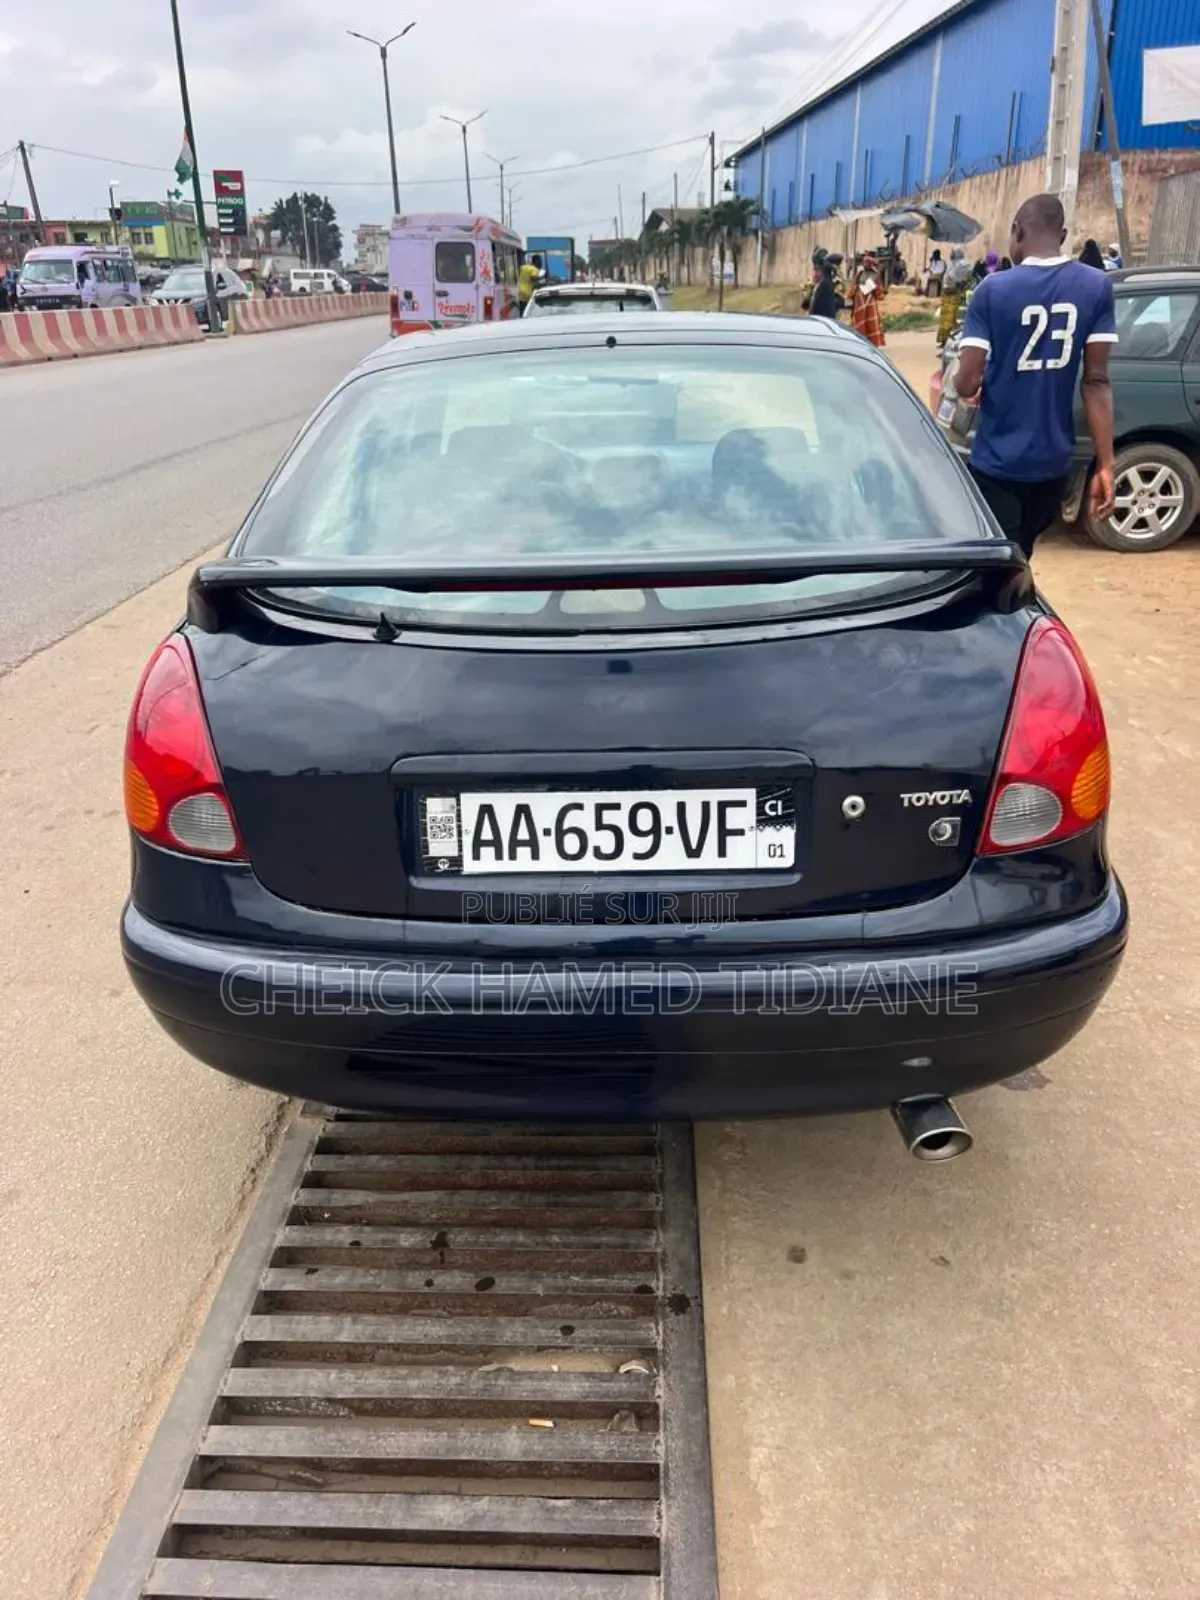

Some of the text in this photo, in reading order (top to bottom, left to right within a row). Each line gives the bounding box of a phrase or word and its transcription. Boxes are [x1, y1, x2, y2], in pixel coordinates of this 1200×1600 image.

[1017, 302, 1078, 372] 23
[900, 789, 972, 807] TOYOTA
[764, 800, 783, 816] CI
[767, 843, 786, 859] 01
